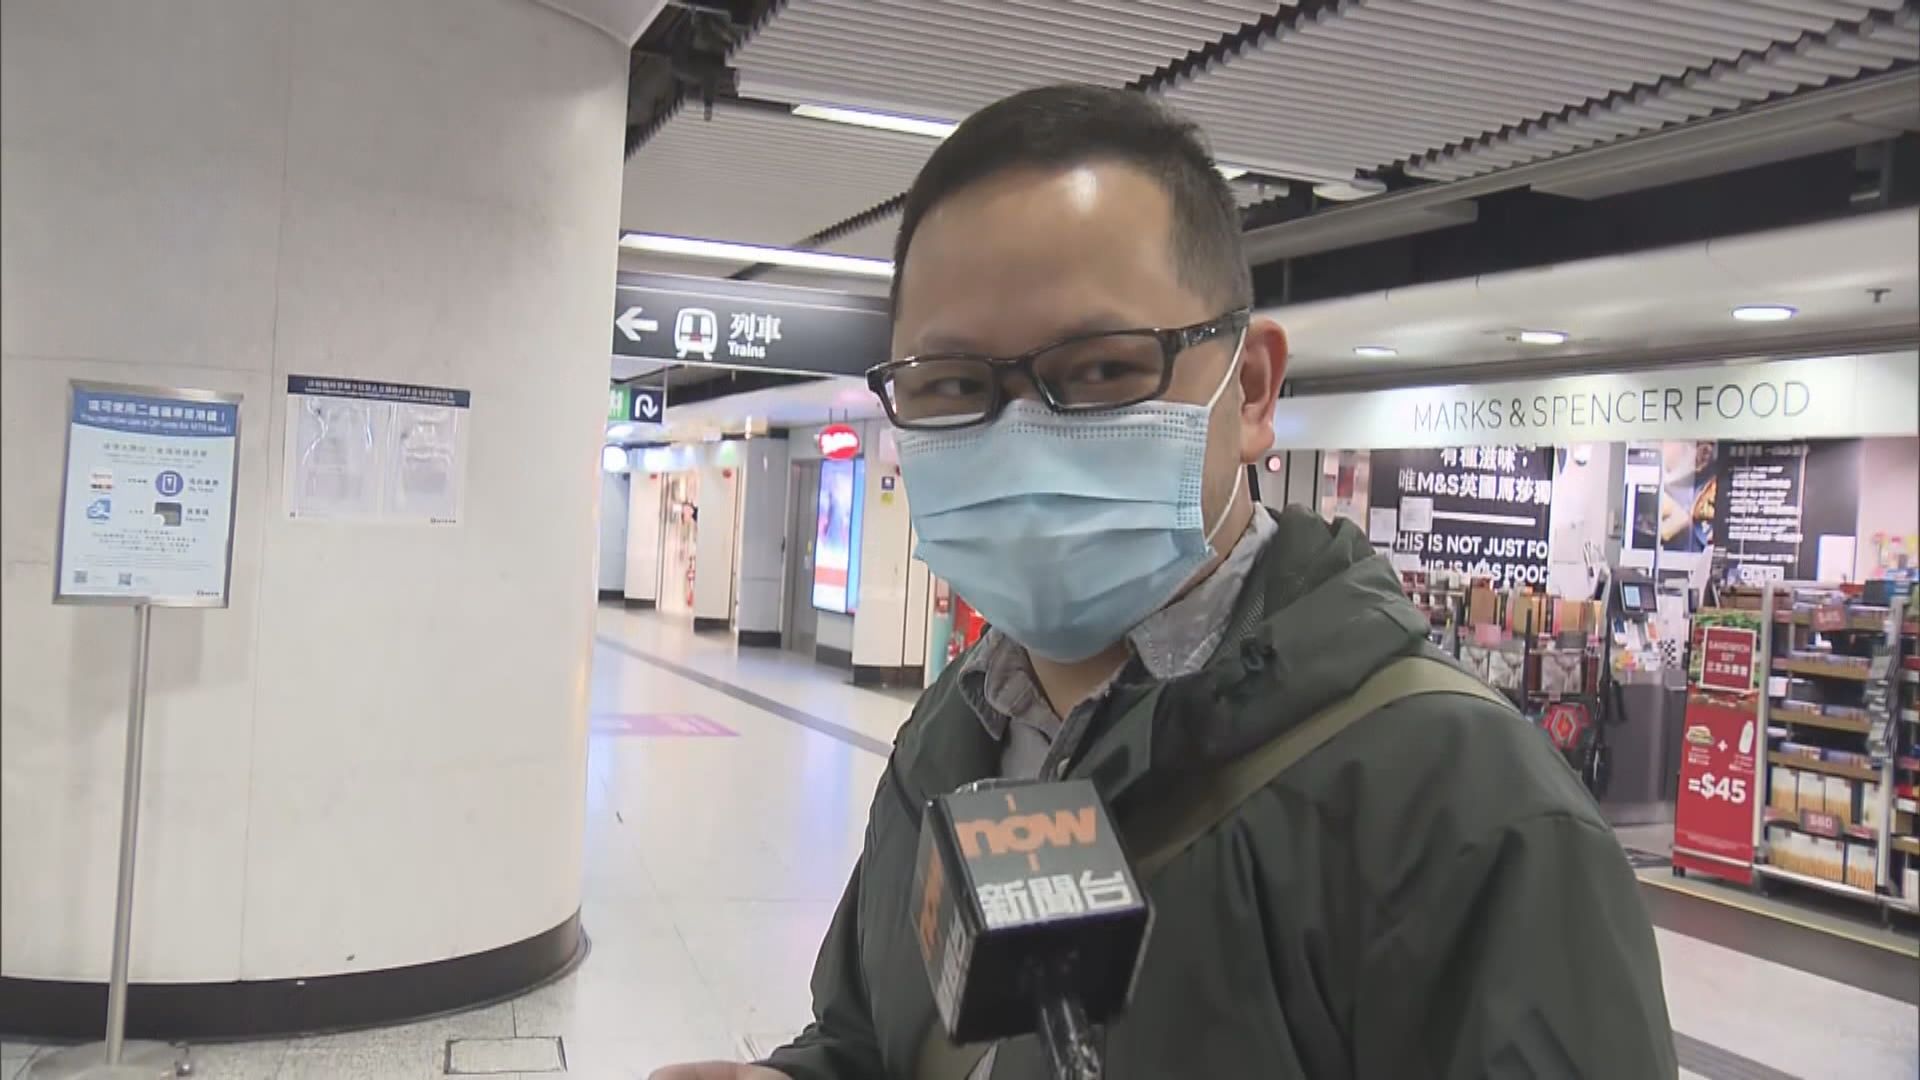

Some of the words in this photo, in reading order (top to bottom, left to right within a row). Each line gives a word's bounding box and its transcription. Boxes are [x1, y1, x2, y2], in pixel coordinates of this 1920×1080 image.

[730, 313, 781, 344] 列車
[728, 340, 766, 359] Trains
[1415, 399, 1502, 432] MARKS
[1509, 399, 1525, 426] &
[1532, 388, 1683, 426] SPENCER
[1695, 382, 1809, 421] FOOD
[1396, 532, 1424, 551] HIS
[1428, 534, 1443, 551] IS
[1446, 535, 1482, 555] NOT
[1483, 537, 1525, 558] JUST
[955, 804, 1097, 858] now
[976, 869, 1133, 930] 新聞台
